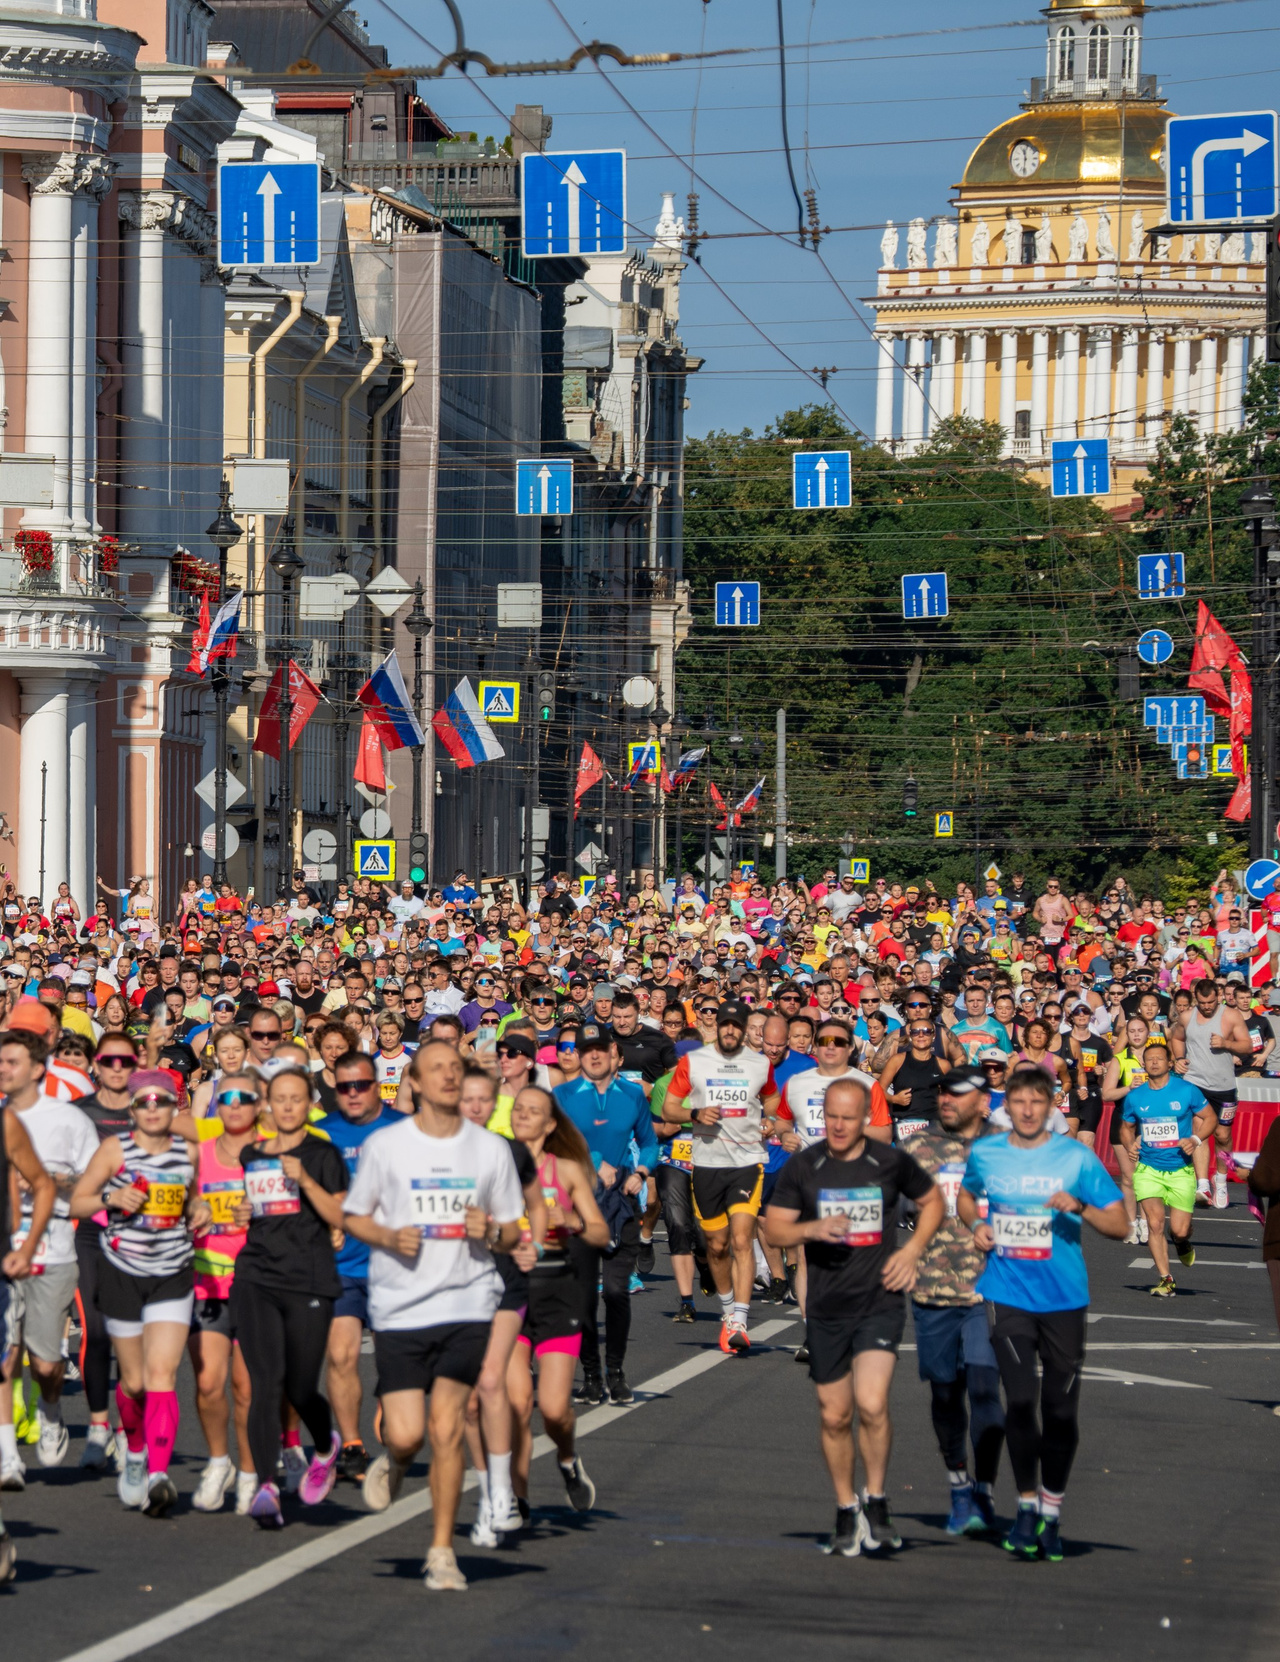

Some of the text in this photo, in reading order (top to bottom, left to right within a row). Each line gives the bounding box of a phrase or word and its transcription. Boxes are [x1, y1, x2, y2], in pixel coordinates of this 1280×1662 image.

[709, 1089, 748, 1102] 14560
[1145, 1125, 1177, 1136] 14389
[249, 1176, 297, 1196] 14932
[1022, 1176, 1063, 1187] РТИ
[149, 1188, 184, 1205] 835
[206, 1196, 242, 1213] 14
[996, 1220, 1050, 1238] 14256
